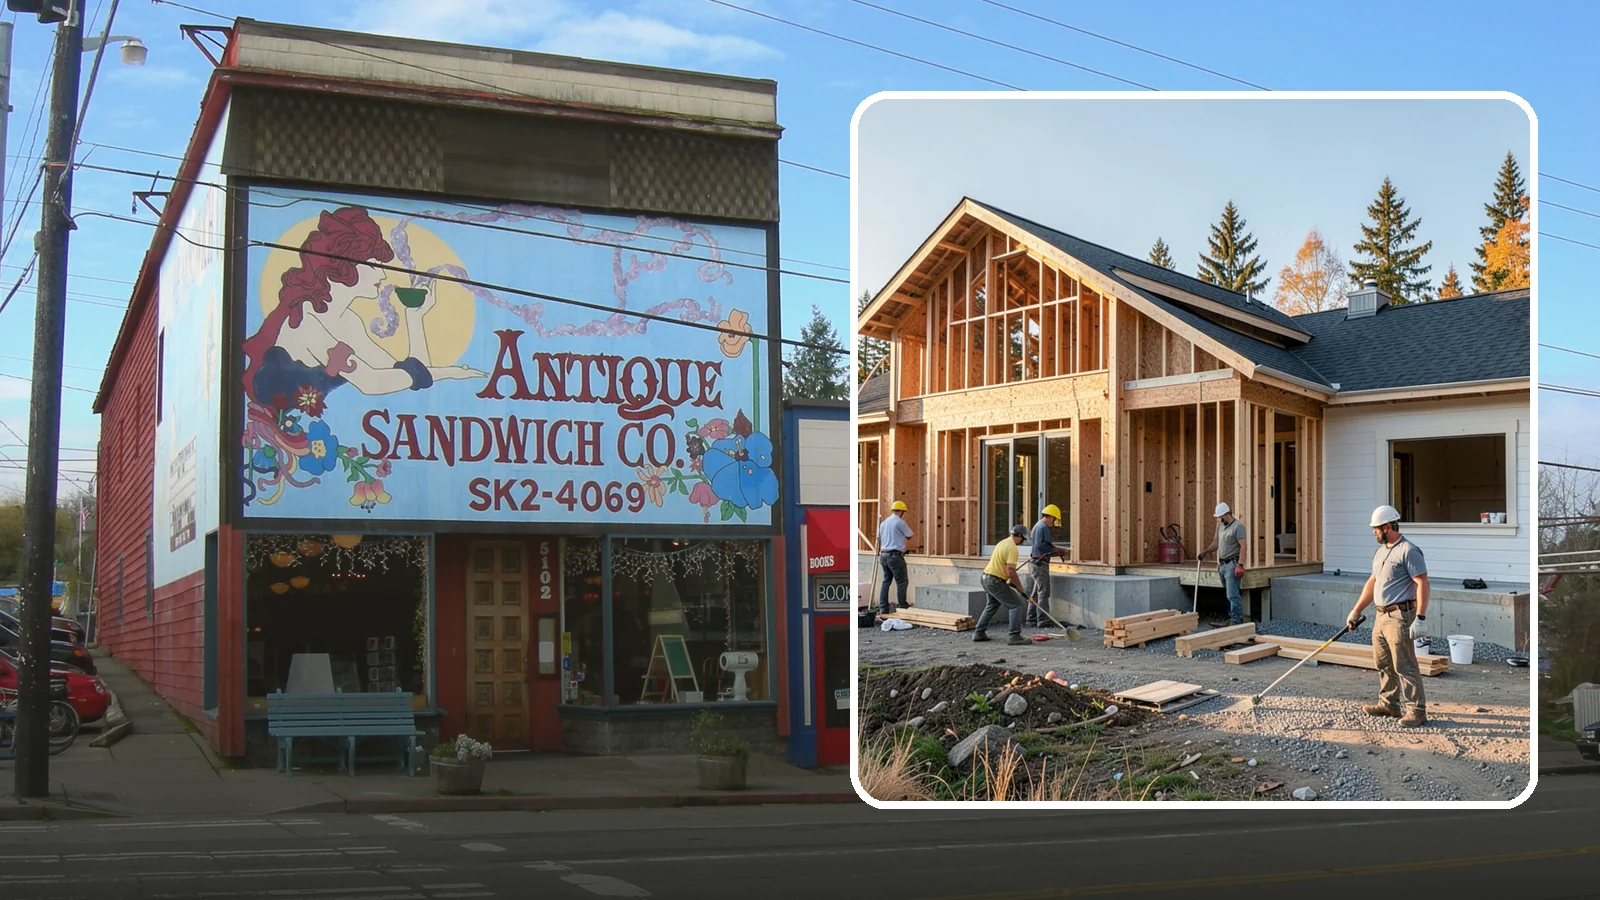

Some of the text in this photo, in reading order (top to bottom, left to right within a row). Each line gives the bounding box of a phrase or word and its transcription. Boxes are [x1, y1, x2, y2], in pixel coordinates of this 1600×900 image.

[475, 329, 724, 421] ANTIQUE
[361, 408, 685, 469] SANDWICH CO.
[468, 476, 646, 513] SK2-4069
[539, 541, 551, 600] 5102
[810, 555, 834, 568] BOOKS
